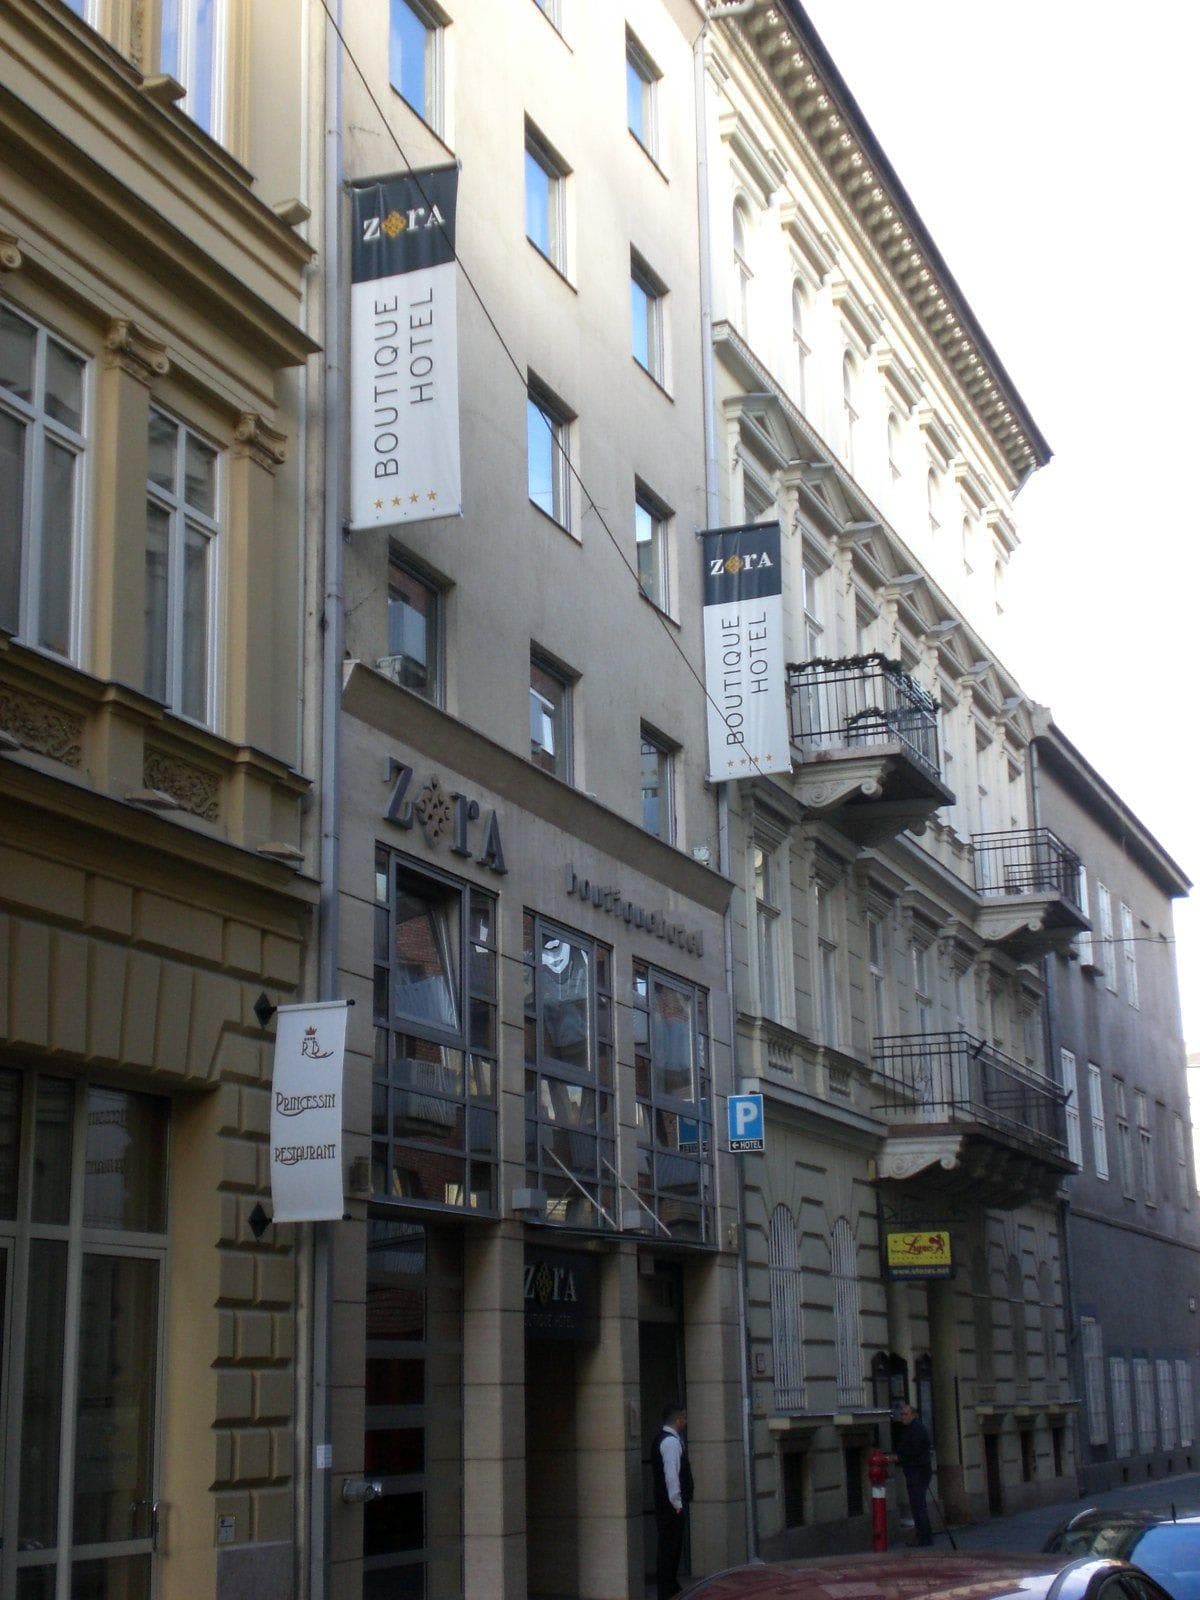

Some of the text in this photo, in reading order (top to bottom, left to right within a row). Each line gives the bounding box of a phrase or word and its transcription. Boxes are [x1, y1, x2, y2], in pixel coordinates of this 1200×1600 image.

[409, 287, 434, 405] HOTEL
[374, 295, 399, 479] BOUTIQUE
[722, 615, 745, 746] BOUTIQUE
[748, 611, 769, 694] HOTEL
[275, 1091, 336, 1117] PRINCESSIN
[735, 1100, 759, 1136] P
[274, 1143, 336, 1166] RESTAURANT
[740, 1140, 762, 1151] HOTEL
